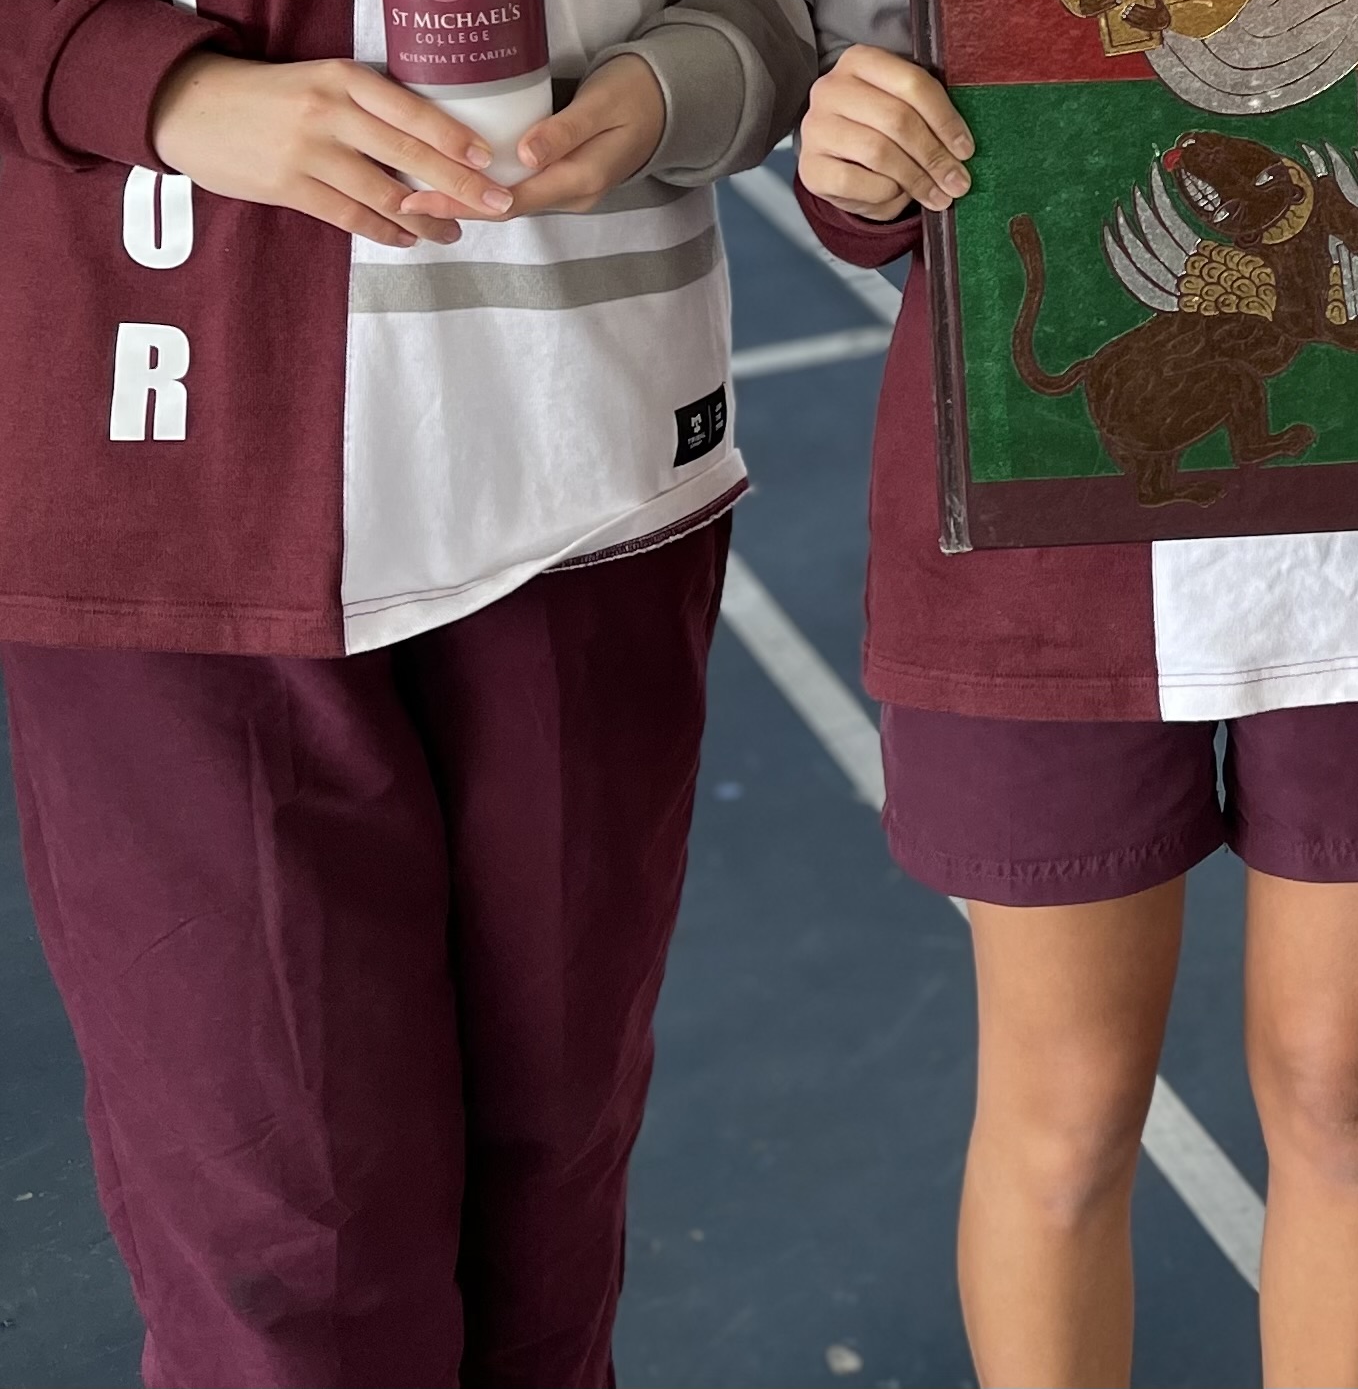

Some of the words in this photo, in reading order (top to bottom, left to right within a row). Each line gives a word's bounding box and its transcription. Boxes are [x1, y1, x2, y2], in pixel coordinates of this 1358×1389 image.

[392, 8, 408, 27] ST
[413, 2, 521, 29] MICHAEL'S
[415, 30, 490, 47] COLLEGE
[399, 51, 447, 64] SCIENTIA
[451, 53, 466, 64] ET
[469, 46, 518, 62] CARITAS
